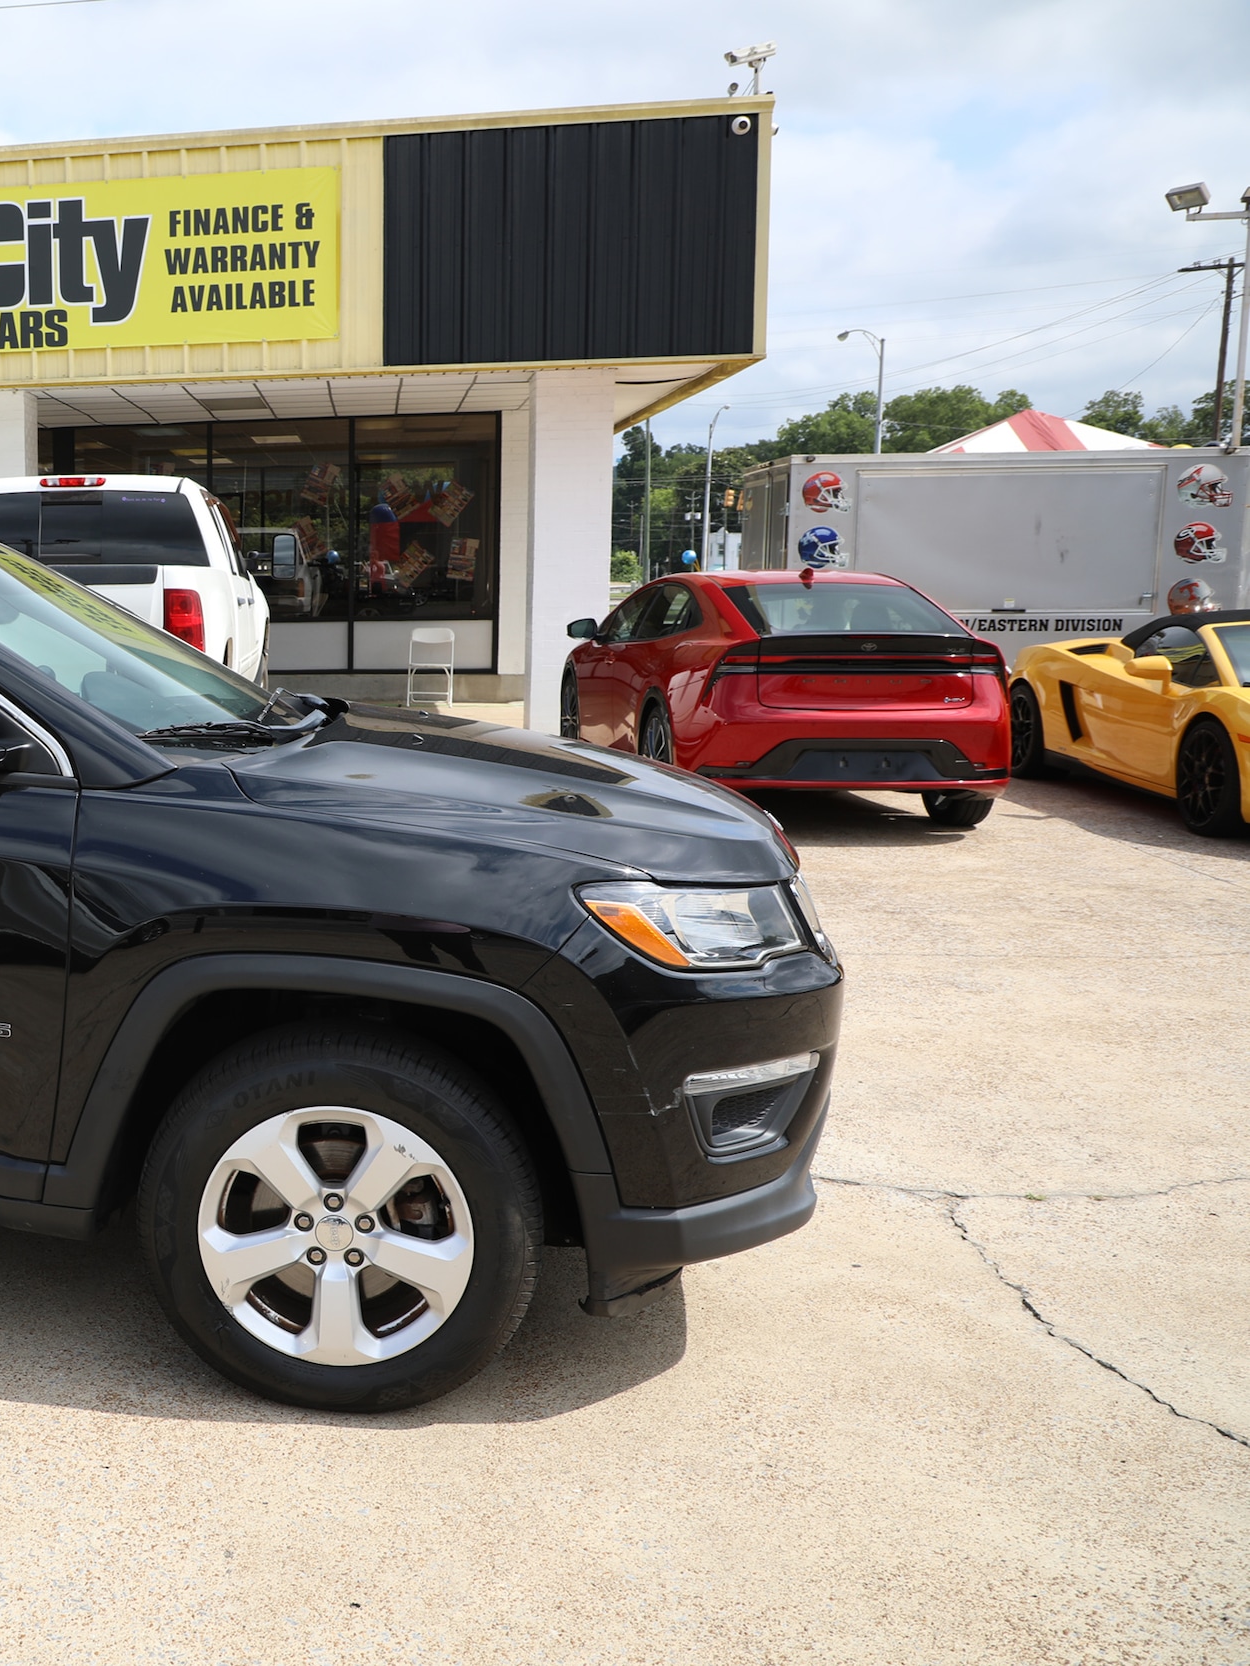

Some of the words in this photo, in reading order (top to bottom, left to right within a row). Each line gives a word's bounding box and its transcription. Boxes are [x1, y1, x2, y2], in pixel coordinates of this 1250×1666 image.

[169, 204, 283, 237] FINANCE
[295, 202, 315, 230] &
[164, 240, 320, 275] WARRANTY
[171, 279, 315, 313] AVAILABLE
[1054, 618, 1123, 632] DIVISION
[232, 1070, 316, 1109] OTANI
